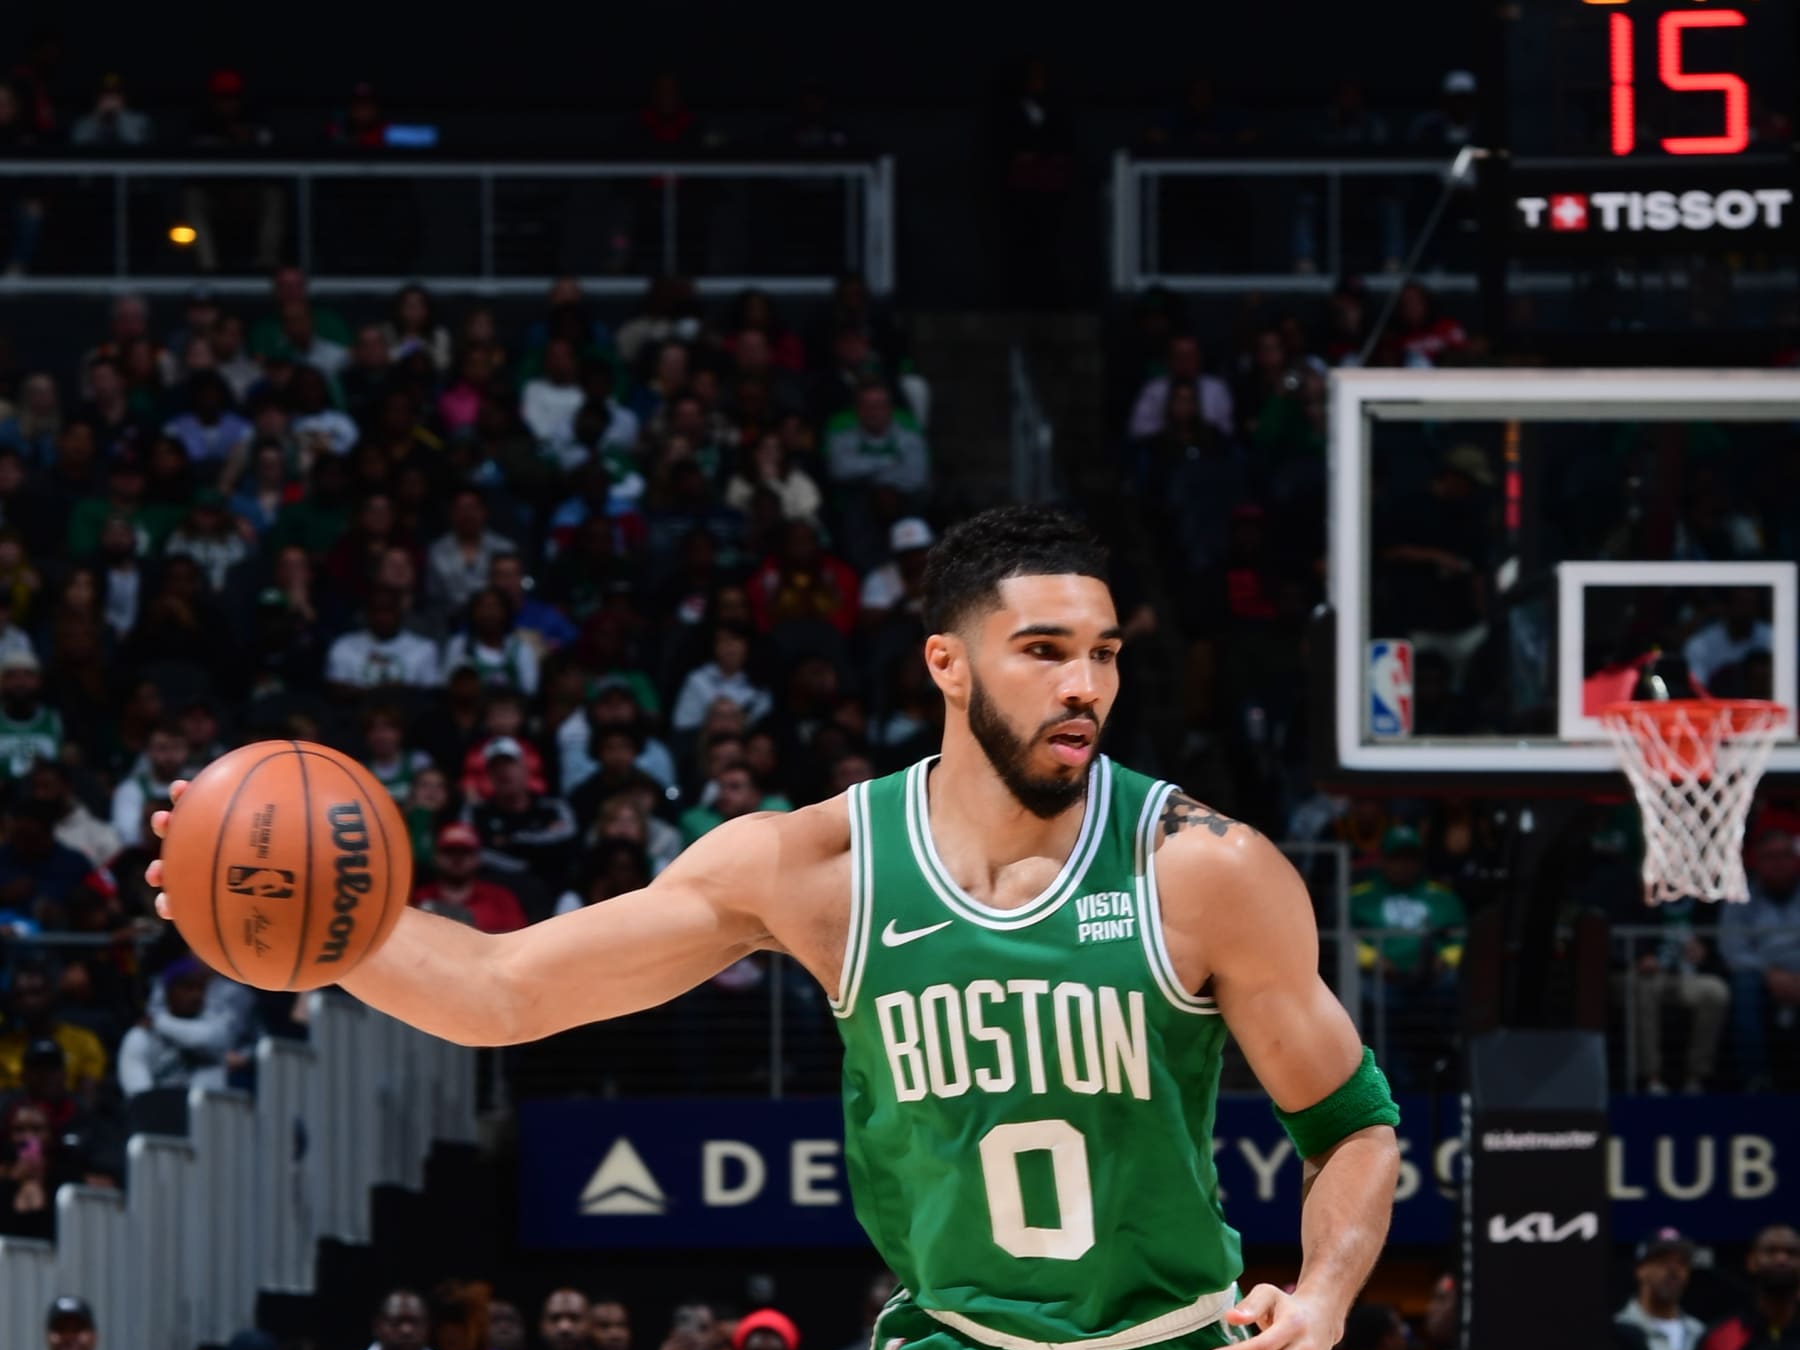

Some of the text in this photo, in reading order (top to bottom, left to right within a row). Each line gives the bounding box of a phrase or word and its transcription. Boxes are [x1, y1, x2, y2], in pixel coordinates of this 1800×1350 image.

[1609, 9, 1750, 156] 15
[1590, 189, 1793, 231] TISSOT
[317, 800, 373, 964] Wilson
[1075, 892, 1134, 919] VISTA
[1078, 918, 1135, 943] PRINT
[875, 979, 1151, 1103] BOSTON
[978, 1118, 1096, 1261] 0
[1607, 1134, 1778, 1200] LUB
